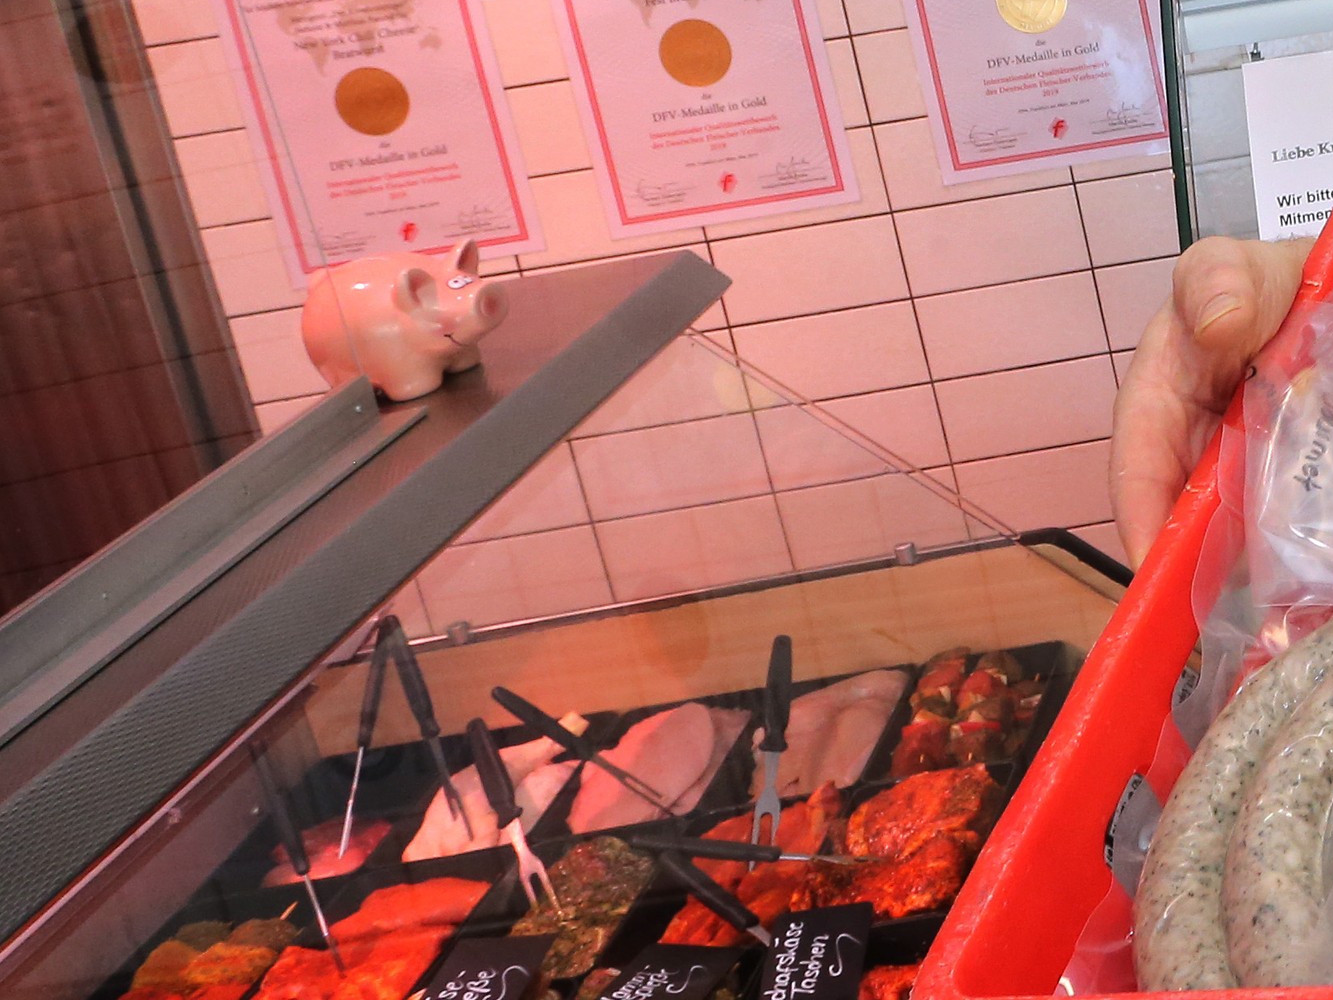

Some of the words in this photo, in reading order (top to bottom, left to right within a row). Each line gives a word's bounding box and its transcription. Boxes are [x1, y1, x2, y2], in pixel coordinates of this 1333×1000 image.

[987, 50, 1059, 68] DFV-Medaille
[1062, 49, 1072, 57] in
[1074, 43, 1100, 55] Gold
[741, 96, 767, 108] Gold
[1272, 146, 1315, 163] Liebe
[1277, 193, 1302, 208] Wir
[764, 922, 803, 1000] chafskäse
[791, 934, 829, 999] Taschen
